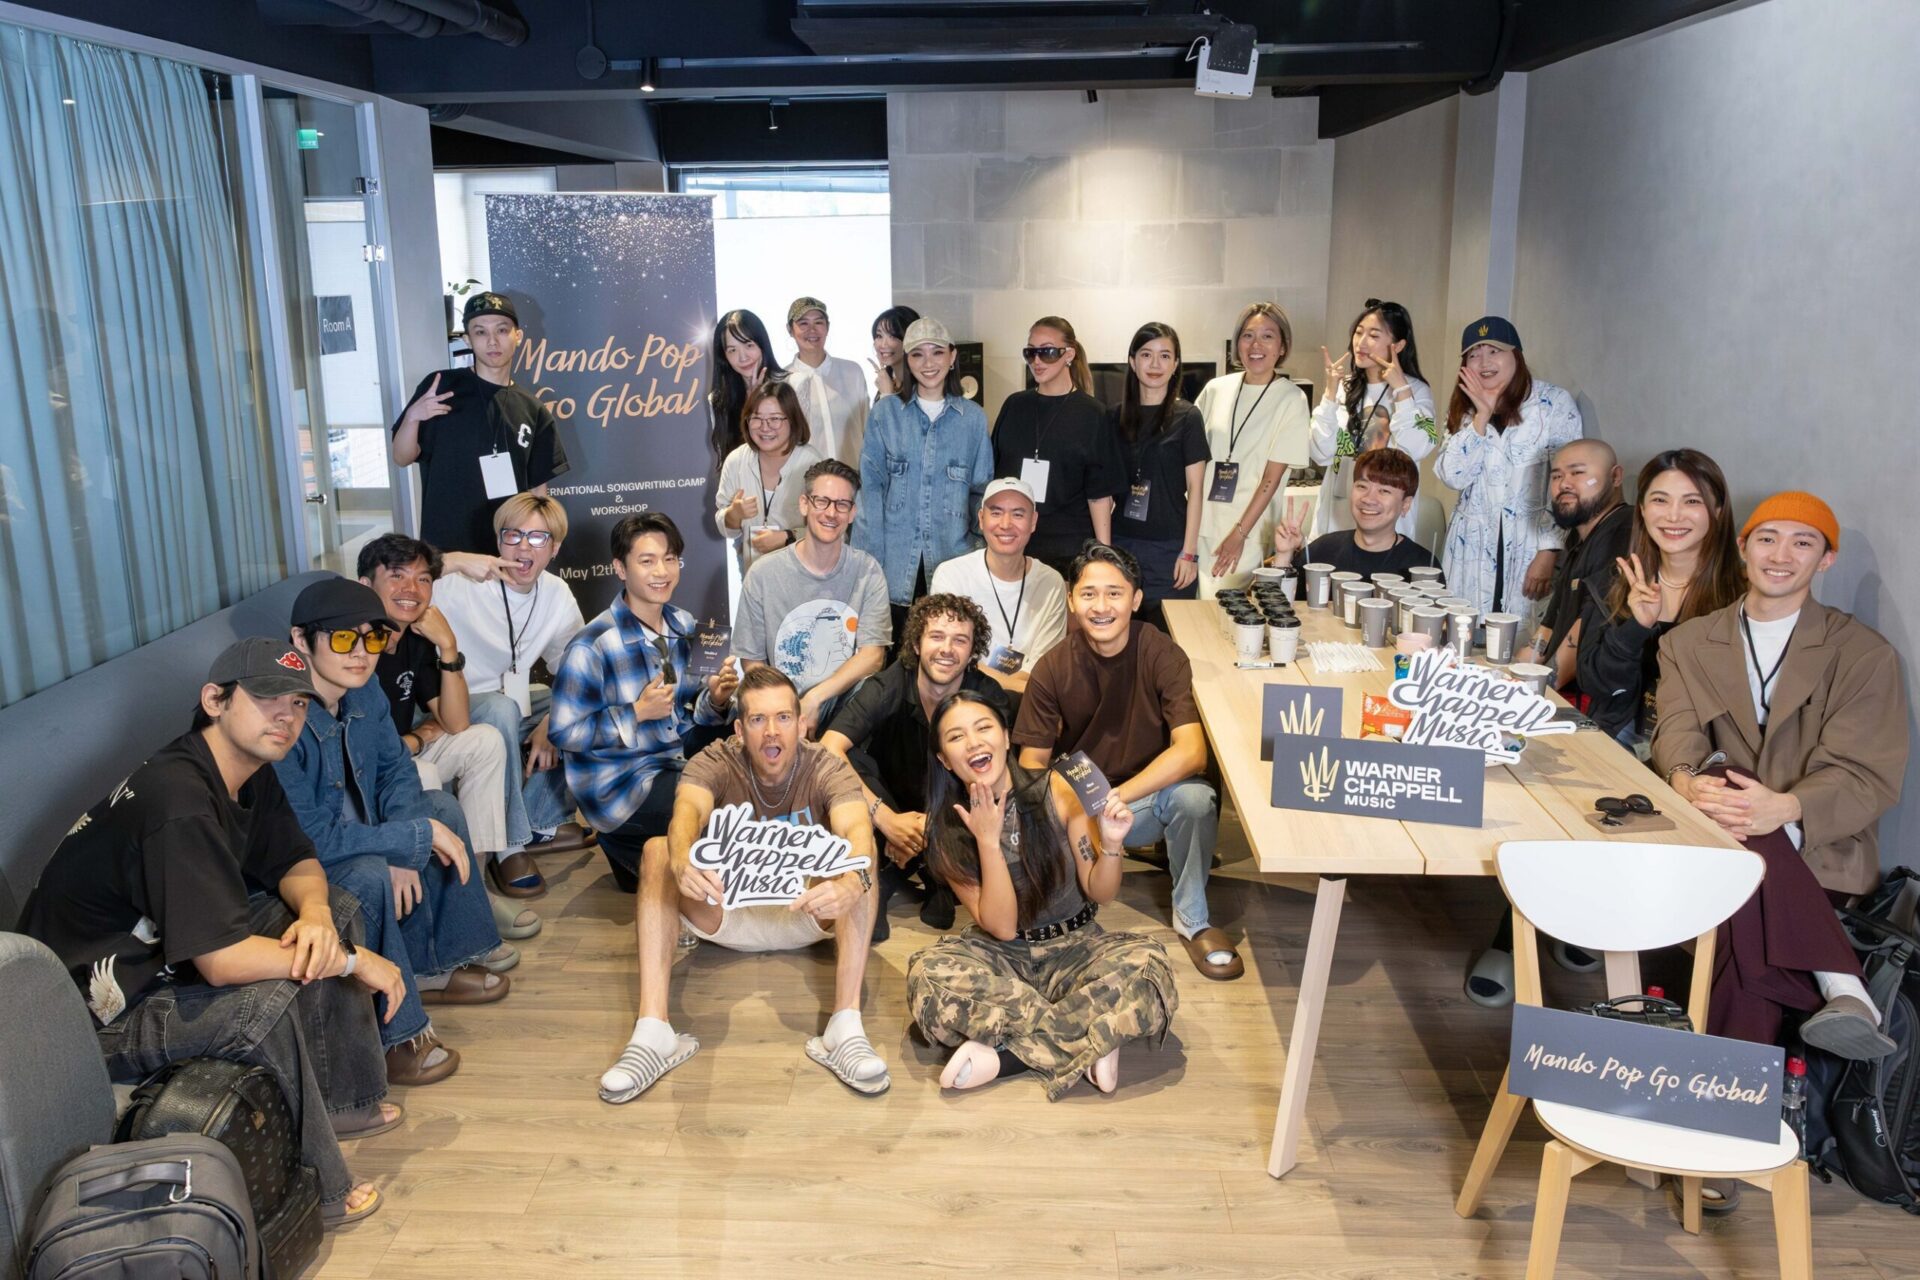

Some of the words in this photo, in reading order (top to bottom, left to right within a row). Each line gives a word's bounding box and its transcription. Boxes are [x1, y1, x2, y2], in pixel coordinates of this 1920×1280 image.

[323, 318, 345, 333] Room
[345, 316, 352, 331] A
[513, 335, 636, 385] Mando
[635, 333, 704, 384] Pop
[586, 378, 700, 428] Global
[547, 484, 606, 497] ERNATIONAL
[607, 479, 676, 493] SONGWRITING
[677, 477, 706, 488] CAMP
[615, 494, 624, 503] &
[590, 503, 649, 516] WORKSHOP
[559, 567, 589, 581] May
[1411, 652, 1530, 704] Warner
[1392, 682, 1572, 732] Chappell
[1344, 759, 1442, 784] WARNER
[1343, 778, 1463, 804] CHAPPELL
[1344, 795, 1396, 810] MUSIC
[712, 807, 825, 856] Warner
[694, 840, 866, 877] Chappell
[1523, 1043, 1598, 1075] Mando
[1600, 1056, 1645, 1090] Pop
[1649, 1065, 1681, 1096] Go
[1688, 1072, 1769, 1105] Global
